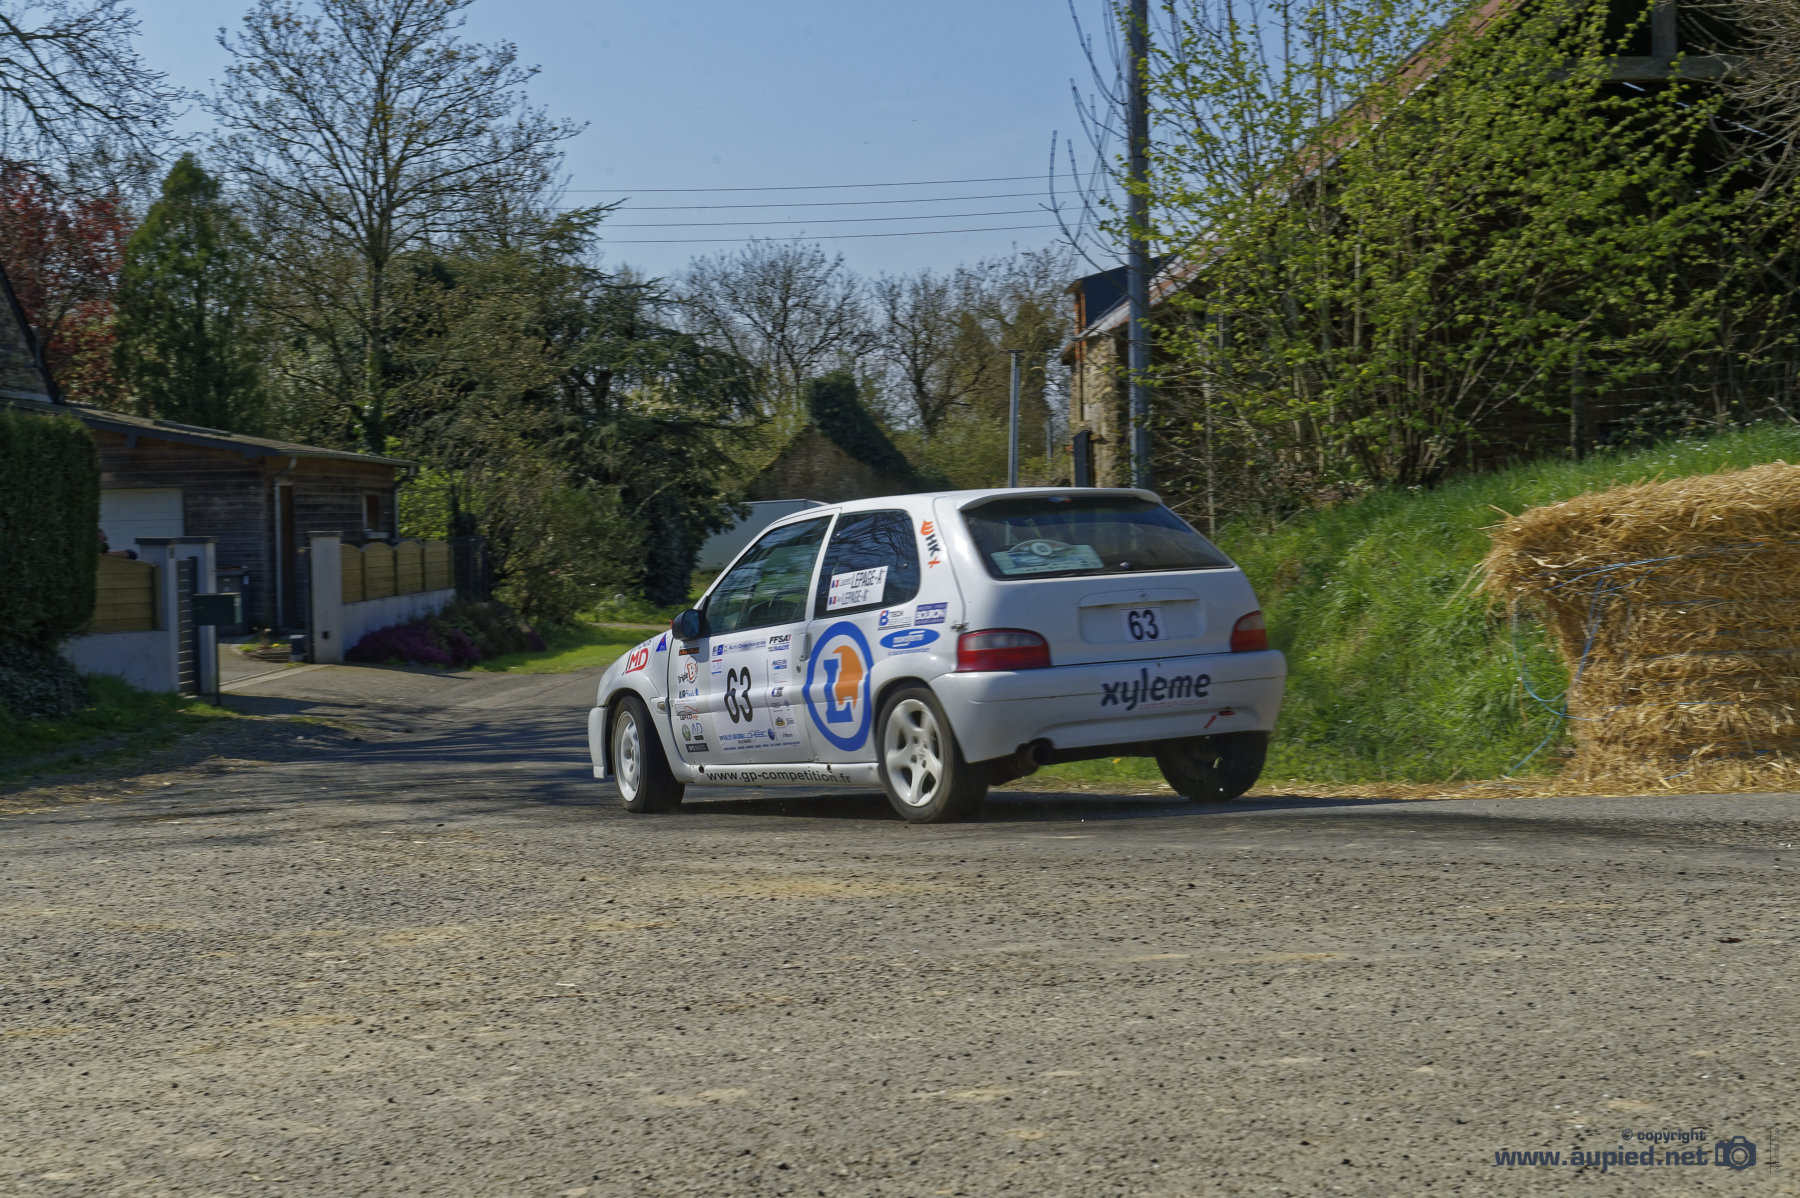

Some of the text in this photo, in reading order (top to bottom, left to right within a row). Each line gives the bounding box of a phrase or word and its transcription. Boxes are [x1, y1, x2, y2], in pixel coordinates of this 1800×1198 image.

[768, 634, 789, 645] FFSA
[1127, 608, 1160, 640] 63
[723, 666, 753, 724] 63
[1100, 667, 1212, 711] xyleme
[706, 769, 851, 784] www.gp-competition.fr
